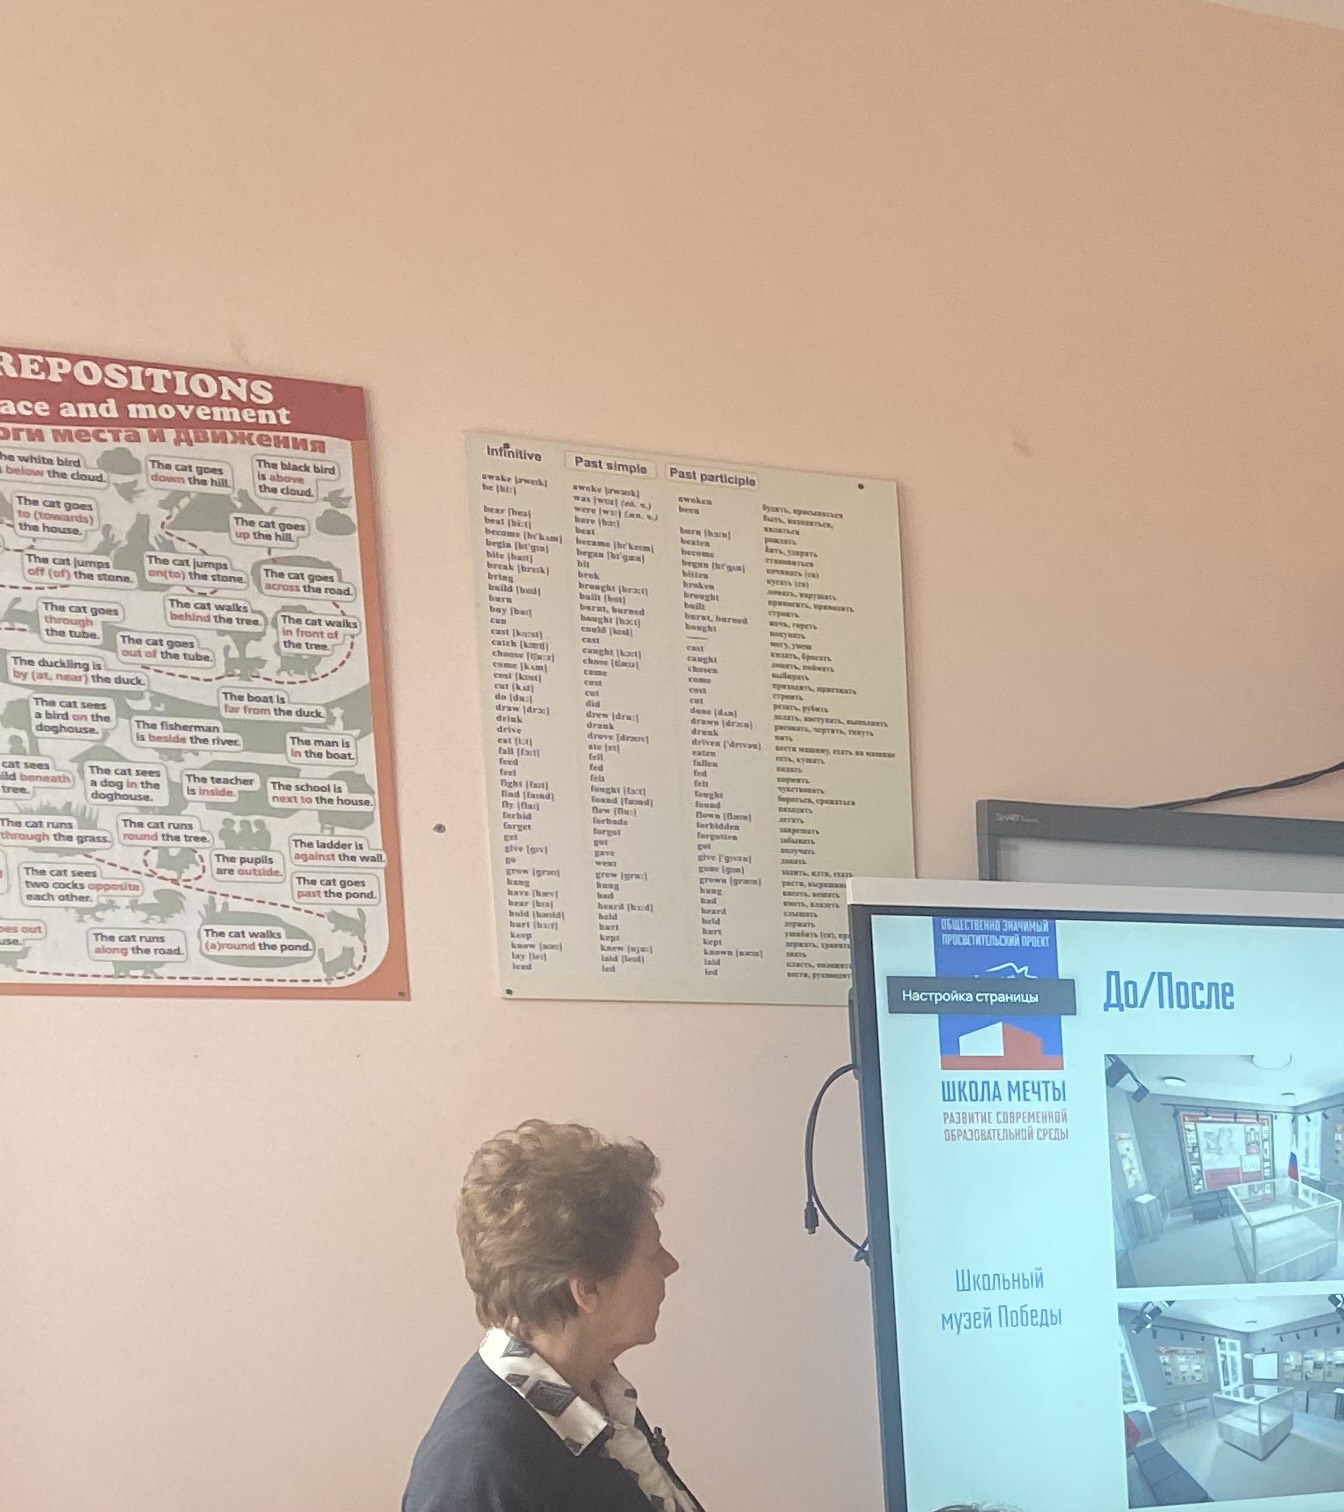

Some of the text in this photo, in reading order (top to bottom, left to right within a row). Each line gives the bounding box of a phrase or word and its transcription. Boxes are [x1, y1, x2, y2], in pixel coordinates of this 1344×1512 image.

[60, 398, 119, 418] and
[128, 404, 291, 424] movement
[51, 428, 141, 443] места
[148, 429, 166, 443] и
[174, 428, 326, 453] движения
[486, 444, 542, 462] Infinitive
[149, 460, 223, 475] The cat goes
[255, 459, 336, 475] The black bird
[575, 456, 648, 475] Past simple
[151, 473, 232, 488] down the hill.
[257, 471, 304, 484] is above
[669, 467, 756, 487] Past participle
[258, 483, 314, 497] the cloud.
[233, 517, 305, 532] The cat goes
[235, 530, 295, 543] up the hill.
[263, 568, 335, 584] The cat goes
[265, 583, 353, 597] across the road.
[168, 599, 248, 613] The cat walks
[170, 611, 262, 627] behind the tree.
[281, 615, 358, 629] The cat walks
[282, 628, 339, 640] in front of
[283, 640, 330, 651] the tree.
[11, 656, 102, 672] The duckling is
[13, 669, 28, 681] by
[91, 674, 111, 684] the
[114, 674, 146, 686] duck.
[222, 691, 286, 704] The boat is
[224, 703, 326, 719] far from the duck.
[135, 720, 220, 733] The fisherman
[136, 732, 241, 747] is beside the river.
[289, 736, 350, 748] The man is
[291, 749, 355, 760] in the boat.
[88, 765, 161, 778] The cat sees
[90, 778, 160, 790] a dog in the
[185, 774, 255, 786] The teacher
[270, 781, 342, 793] The school is
[91, 791, 154, 802] doghouse.
[187, 785, 236, 797] is inside.
[272, 794, 374, 807] next to the house.
[292, 839, 364, 850] The ladder is
[214, 853, 274, 867] The pupils
[294, 852, 386, 863] against the wall.
[216, 867, 284, 877] are outside.
[941, 918, 1048, 933] ОБЩЕСТВЕННО ЗНАЧИМЫЙ
[942, 933, 1050, 948] ПРОСВЕТИТЕЛЬСКИЙ ПРОЕКТ
[902, 989, 1039, 1005] Настройка страницы
[1103, 970, 1235, 1012] До/После
[941, 1080, 1066, 1102] ШКОЛА МЕЧТЫ
[943, 1109, 1067, 1124] РАЗВИТИЕ СОВРЕМЕННОЙ
[944, 1126, 1069, 1142] ОБРАЗОВАТЕЛЬНОЙ СРЕДЫ
[956, 1266, 1044, 1293] Школьный
[940, 1304, 1063, 1335] музей Победы
